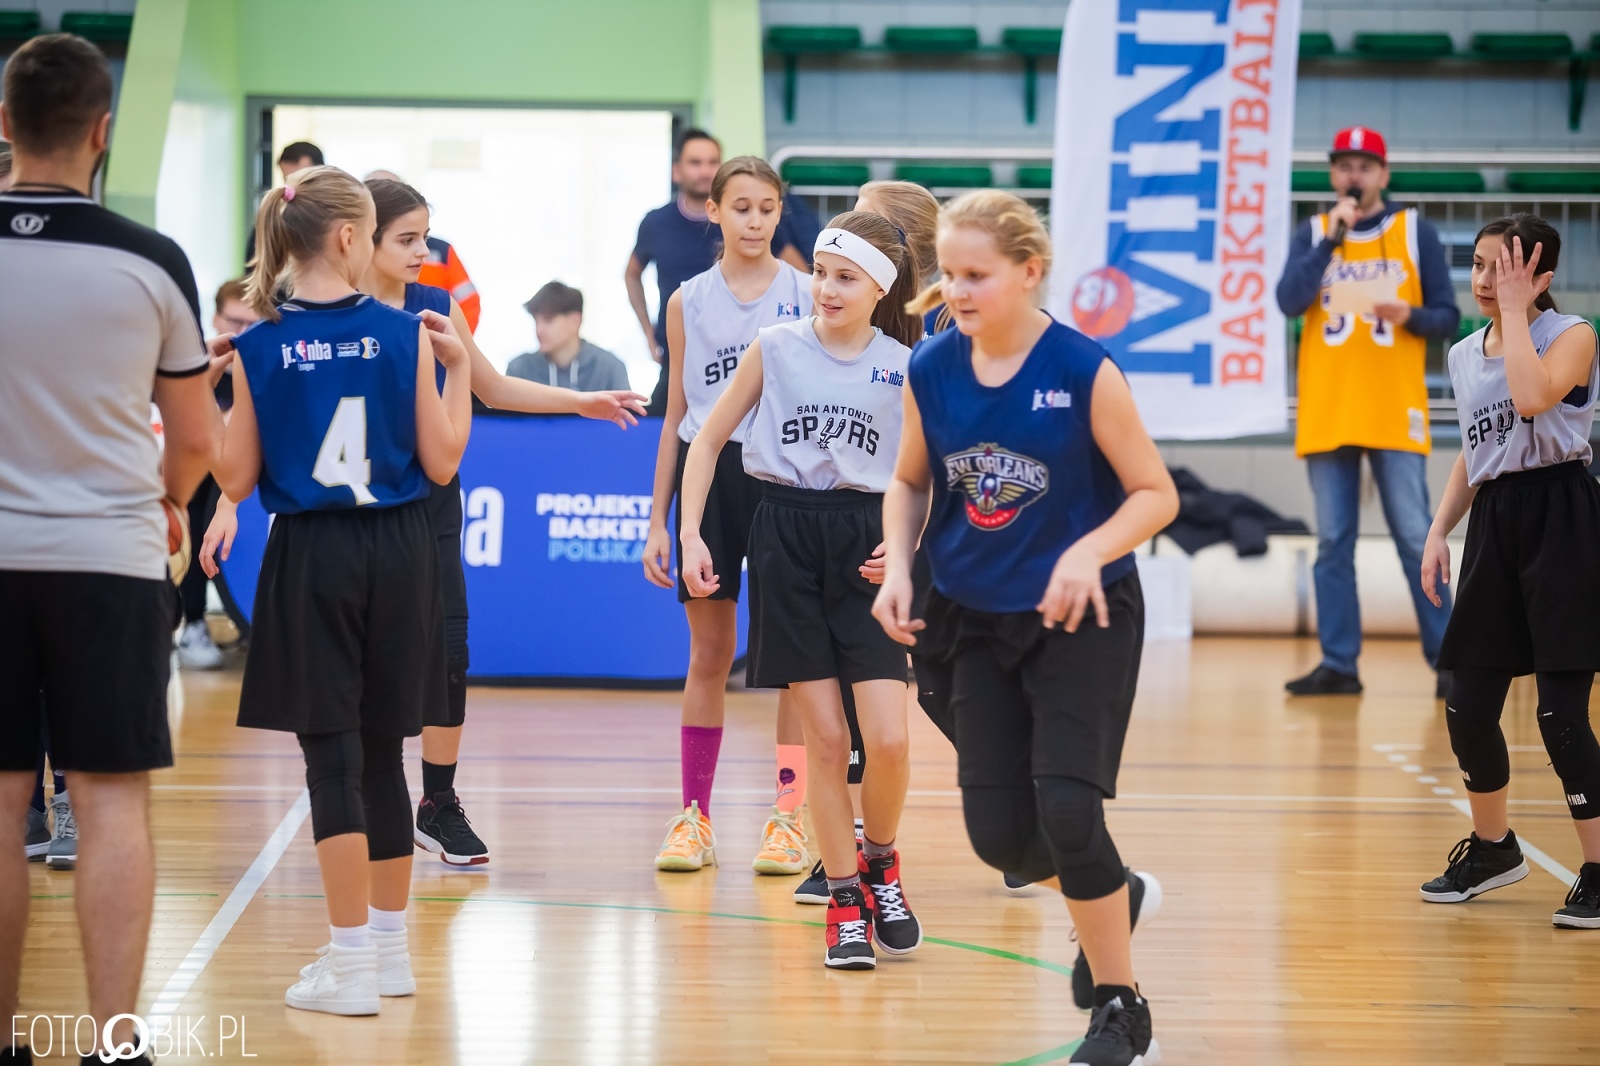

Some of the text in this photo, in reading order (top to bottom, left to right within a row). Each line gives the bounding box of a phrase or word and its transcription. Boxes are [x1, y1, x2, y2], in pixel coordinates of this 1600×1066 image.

[281, 343, 297, 369] jr.
[306, 339, 333, 361] nba
[716, 346, 737, 358] SAN
[871, 366, 904, 387] jr. nba
[797, 404, 874, 424] SAN ANTONIO
[1473, 405, 1490, 420] SAN
[781, 415, 880, 457] SPURS
[311, 396, 379, 506] 4
[946, 456, 1046, 489] EW ORLEANS
[536, 492, 653, 518] PROJEKT
[548, 516, 650, 541] BASKET
[1571, 793, 1588, 805] NBA
